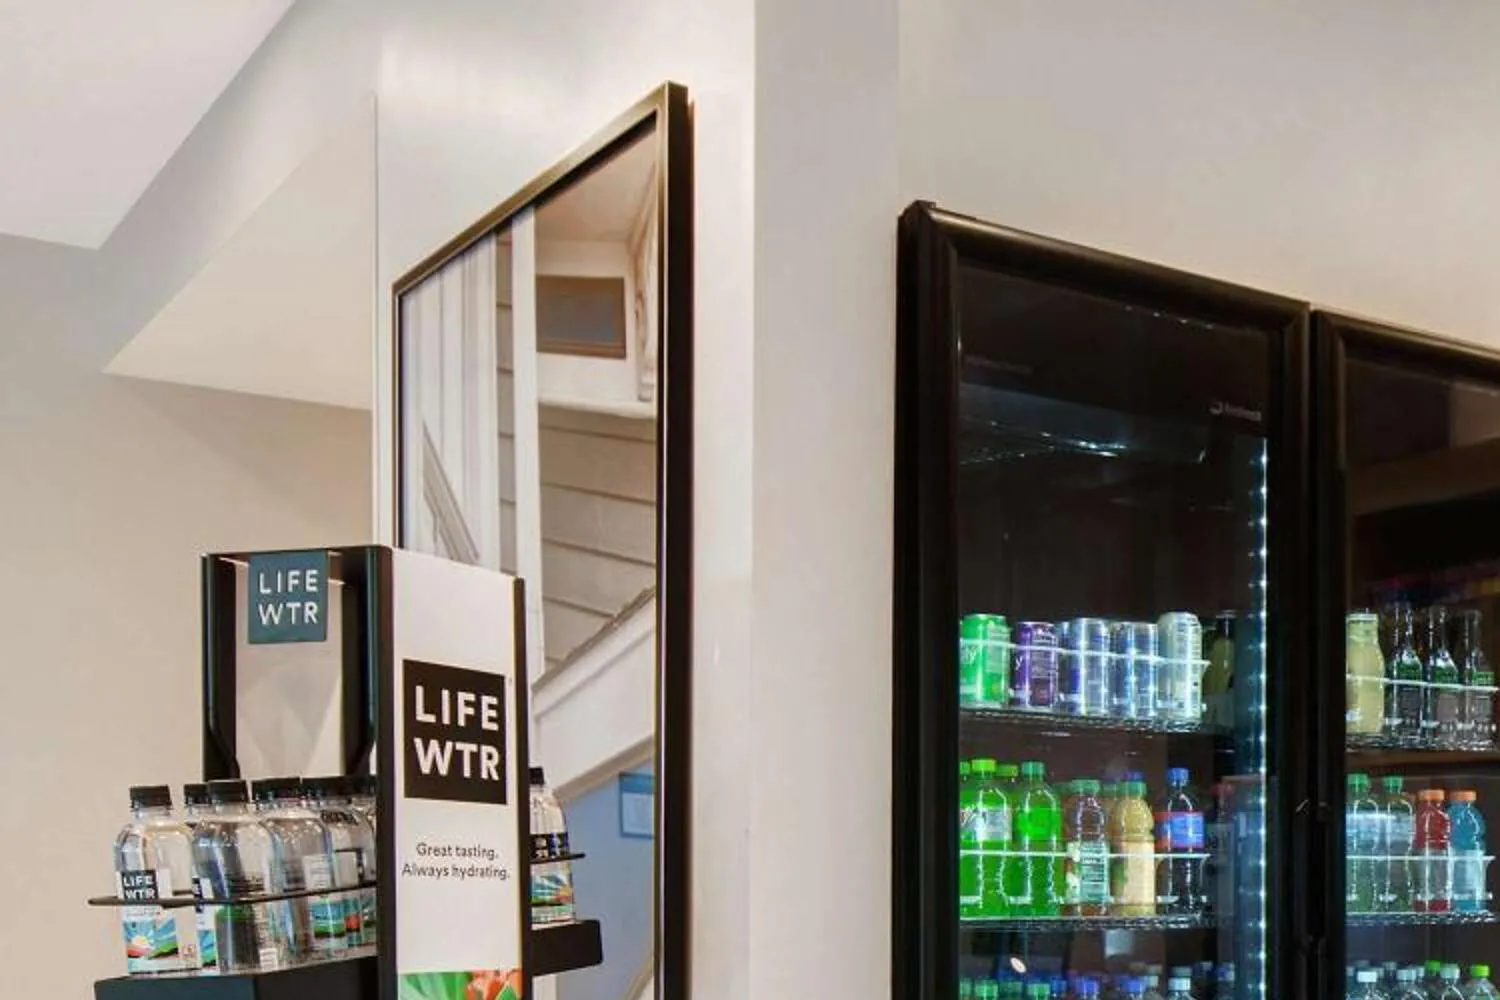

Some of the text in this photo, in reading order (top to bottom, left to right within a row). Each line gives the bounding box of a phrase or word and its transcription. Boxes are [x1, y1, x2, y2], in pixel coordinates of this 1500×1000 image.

[259, 569, 319, 594] LIFE
[257, 601, 319, 625] WTR
[415, 684, 499, 732] LIFE
[413, 736, 500, 781] WTR
[416, 842, 499, 861] Great tasting.
[123, 875, 154, 888] LIFE
[402, 863, 510, 881] Always hydrating.
[125, 888, 156, 900] WTR
